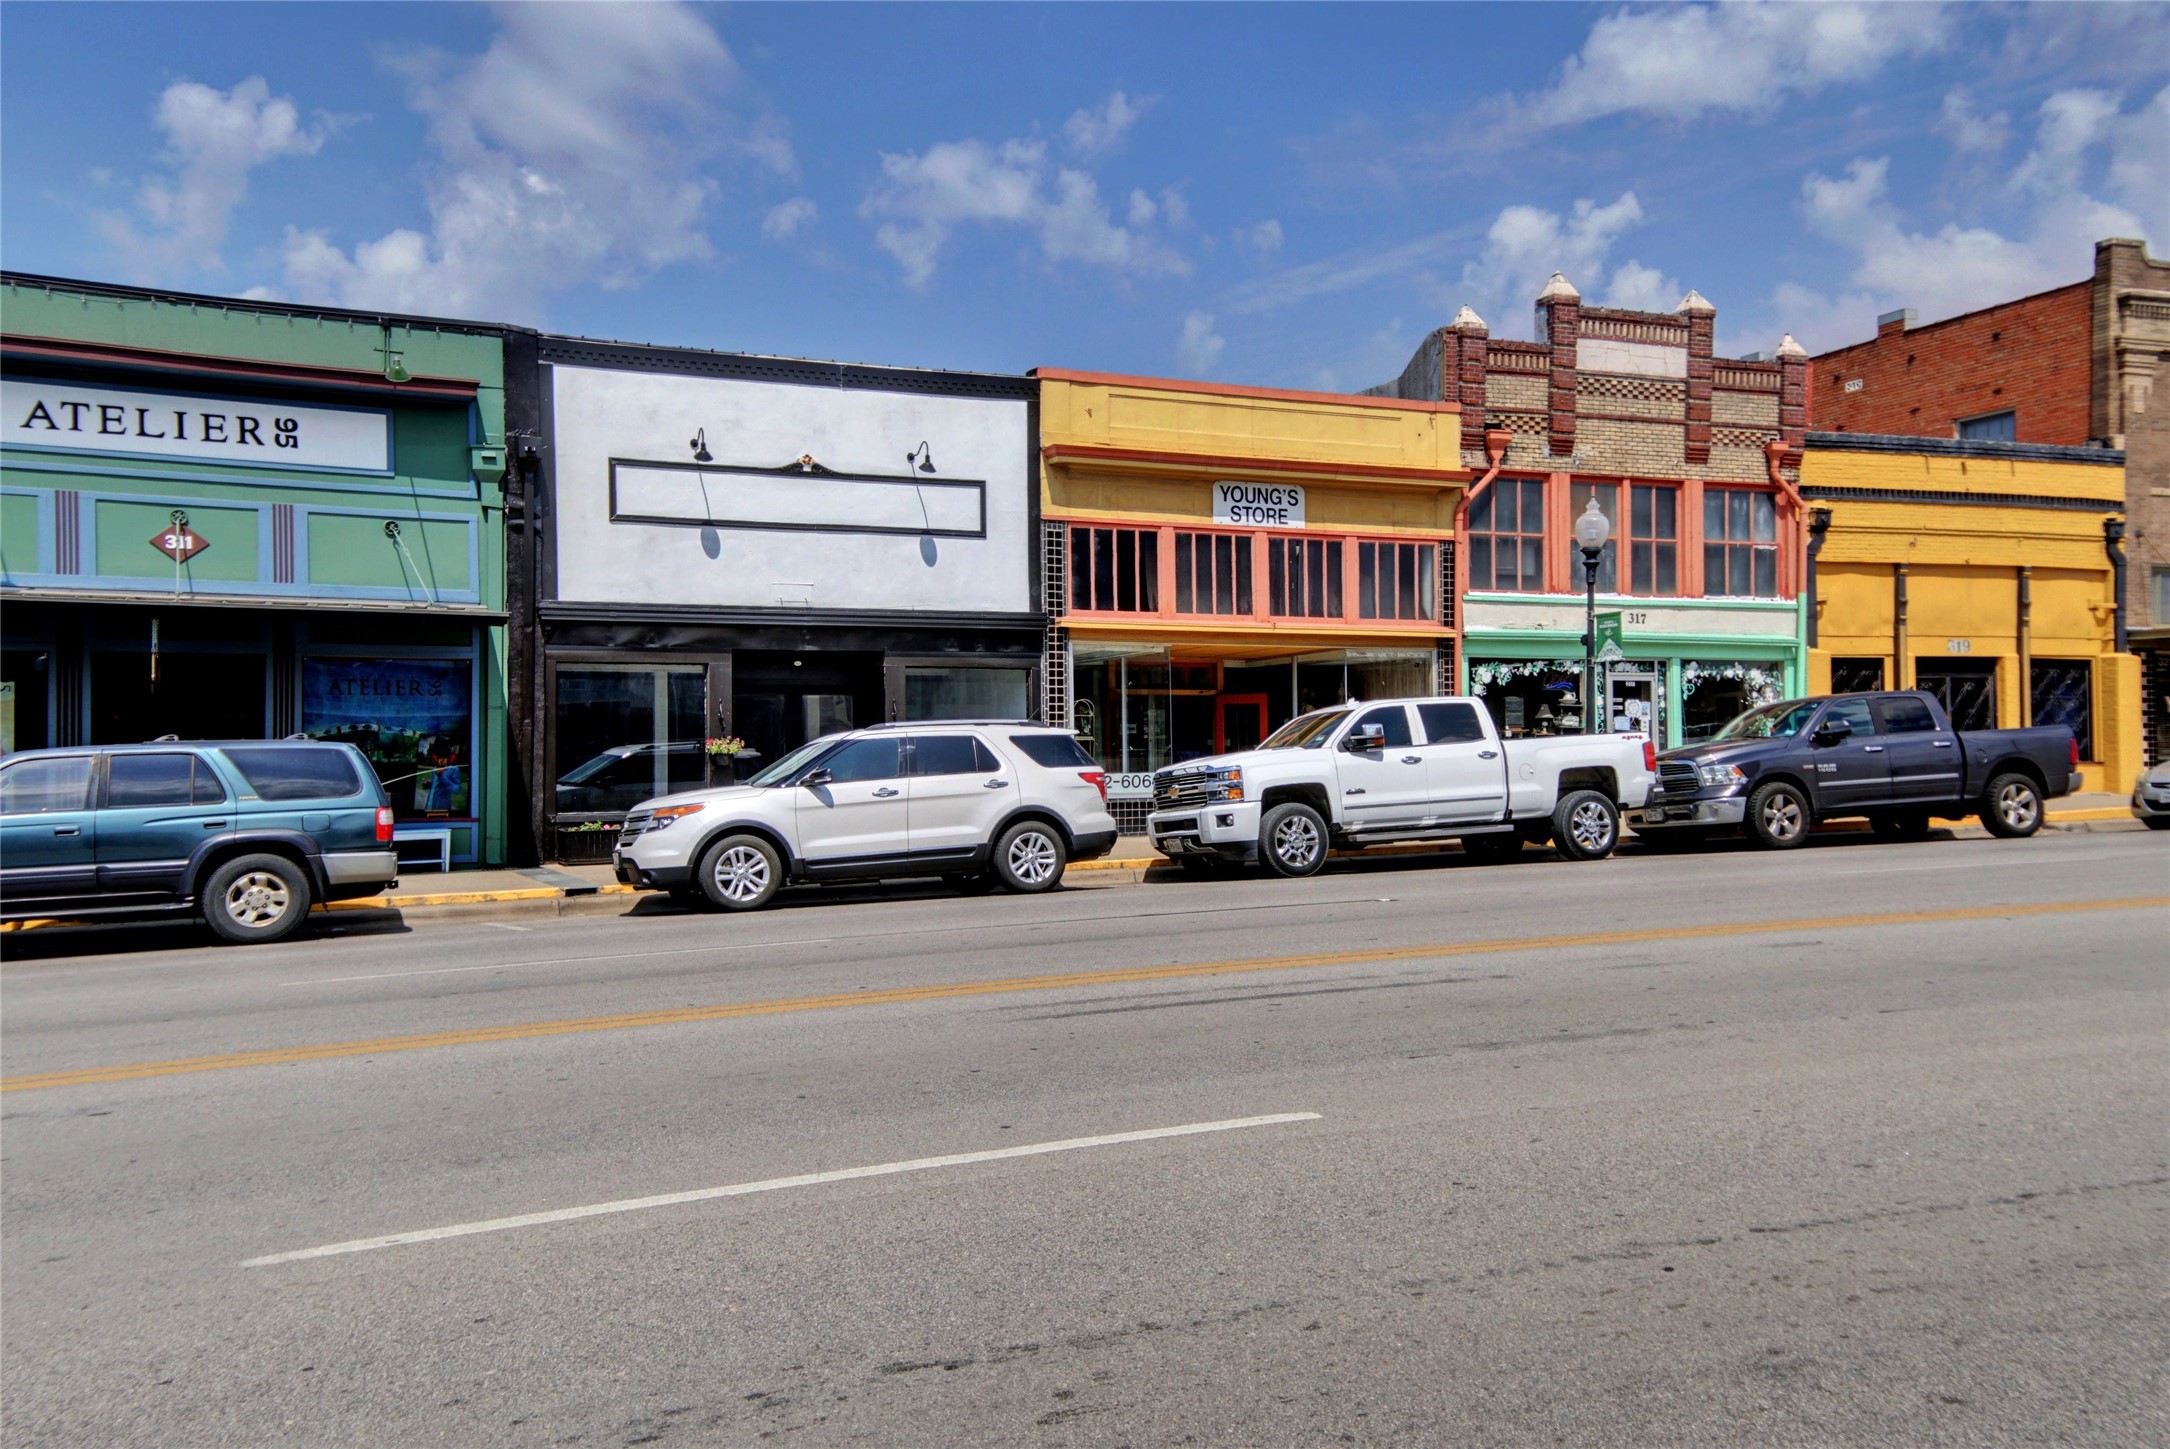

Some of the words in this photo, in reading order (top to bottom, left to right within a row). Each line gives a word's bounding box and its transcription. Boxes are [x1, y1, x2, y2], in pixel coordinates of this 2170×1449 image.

[20, 400, 265, 446] ATELIER
[274, 417, 299, 449] 95
[1220, 485, 1299, 506] YOUNG'S
[1230, 505, 1288, 525] STORE
[164, 534, 193, 550] 311
[1628, 612, 1647, 625] 317
[328, 677, 424, 697] ATELIER
[1104, 774, 1154, 789] 2-606
